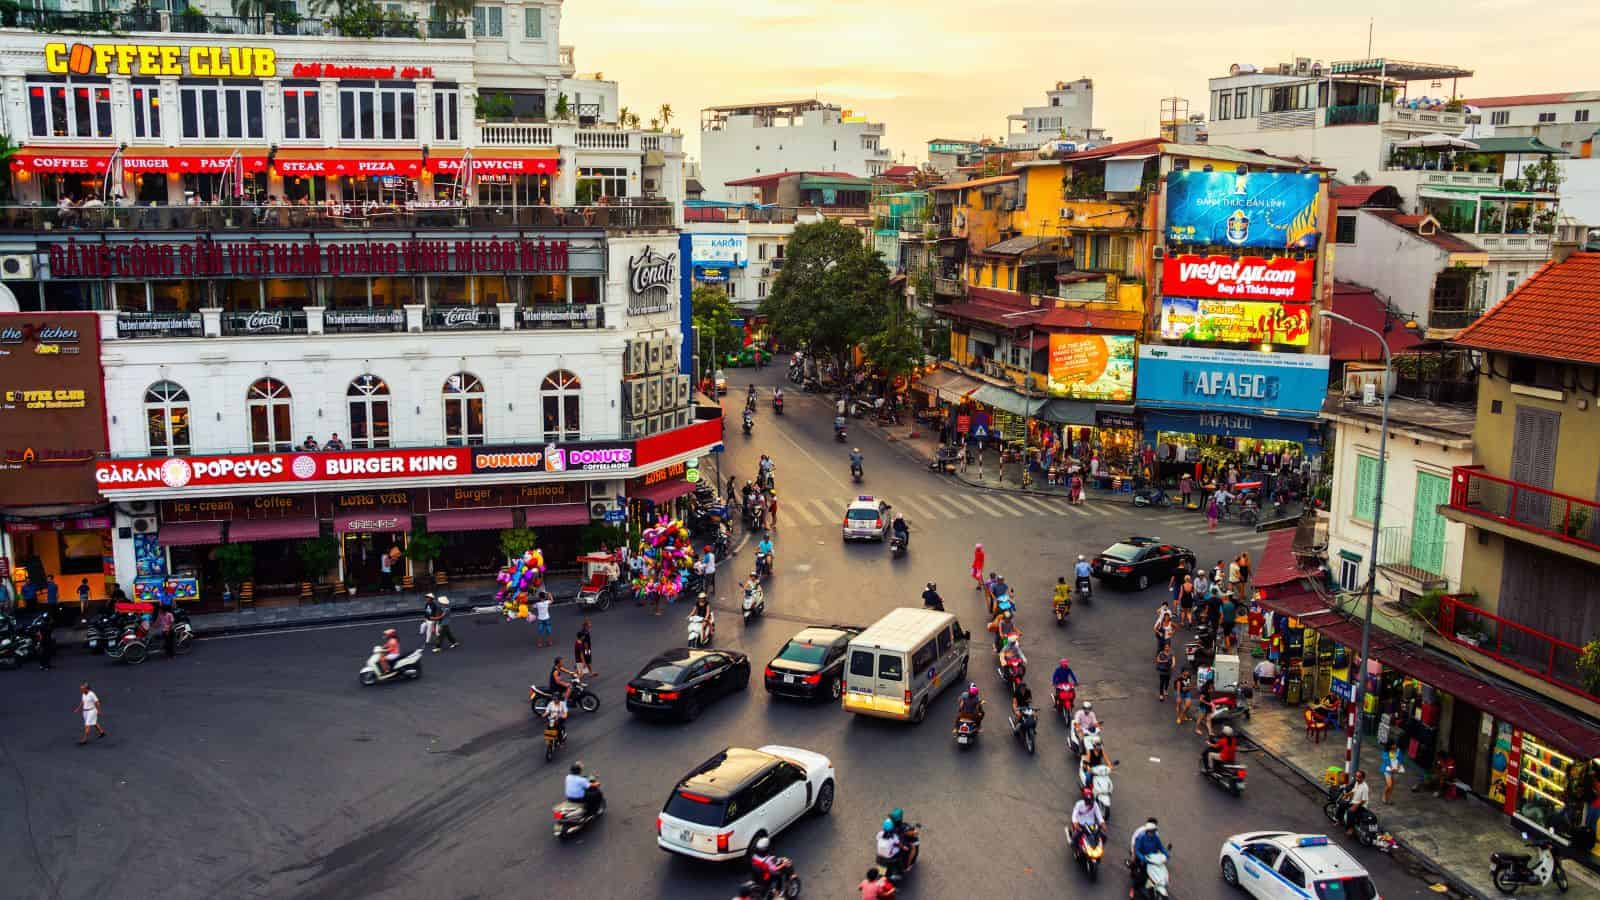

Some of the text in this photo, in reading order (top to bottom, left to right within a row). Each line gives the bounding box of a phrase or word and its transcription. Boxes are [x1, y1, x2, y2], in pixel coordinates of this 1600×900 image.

[45, 43, 277, 77] COFFEE CLUB
[33, 158, 89, 168] COFFEE
[124, 159, 169, 168] BURGER
[200, 158, 240, 168] PAST
[283, 162, 325, 171] STEAK
[359, 162, 395, 171] PIZZA
[1, 327, 22, 338] the
[476, 449, 632, 468] DUNKIN' DONUTS
[326, 458, 405, 475] BURGER
[409, 456, 457, 471] KING
[455, 488, 490, 501] Burger
[521, 485, 565, 496] Fastfood
[255, 497, 293, 508] Coffee
